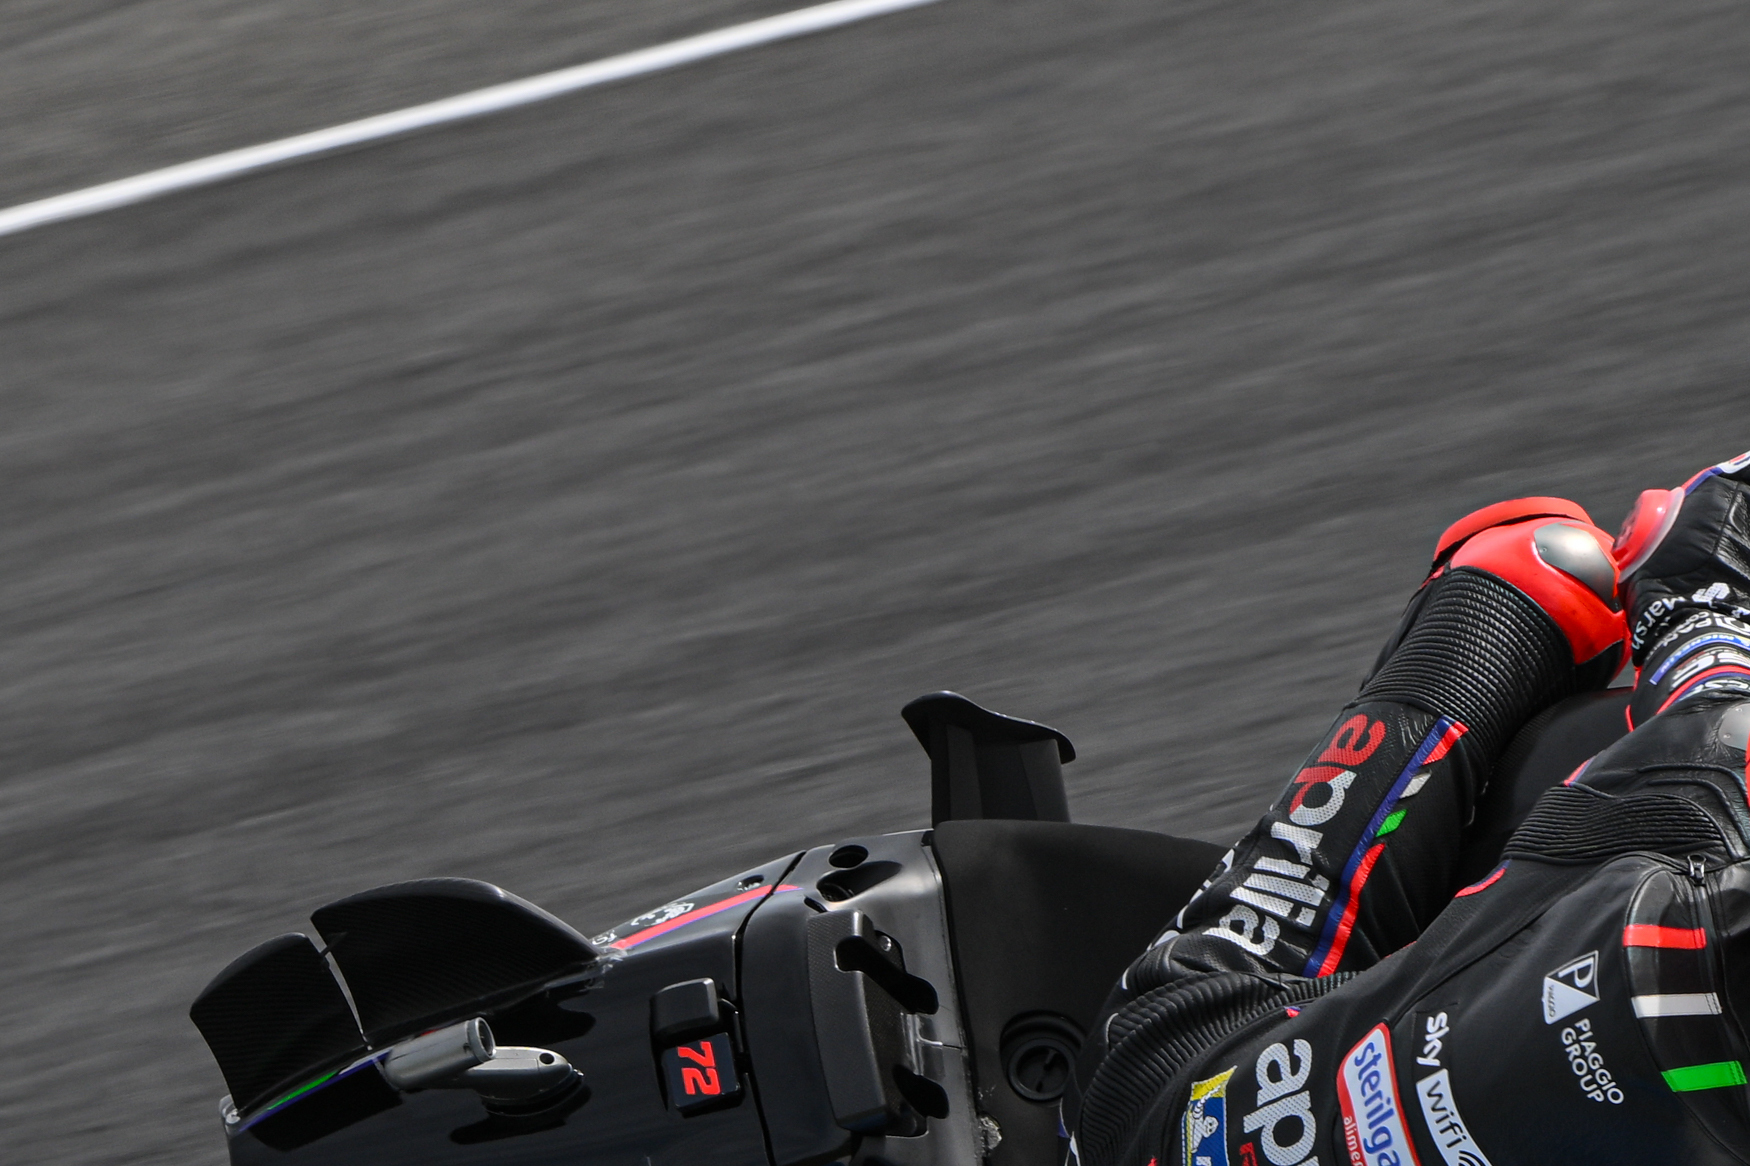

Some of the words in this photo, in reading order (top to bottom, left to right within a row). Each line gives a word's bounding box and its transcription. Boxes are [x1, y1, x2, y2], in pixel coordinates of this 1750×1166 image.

[1631, 596, 1686, 650] Marsh
[1203, 713, 1386, 956] aprilia
[676, 1038, 723, 1096] 72
[1560, 1027, 1605, 1103] GROUP
[1574, 1017, 1625, 1105] PIAGGIO
